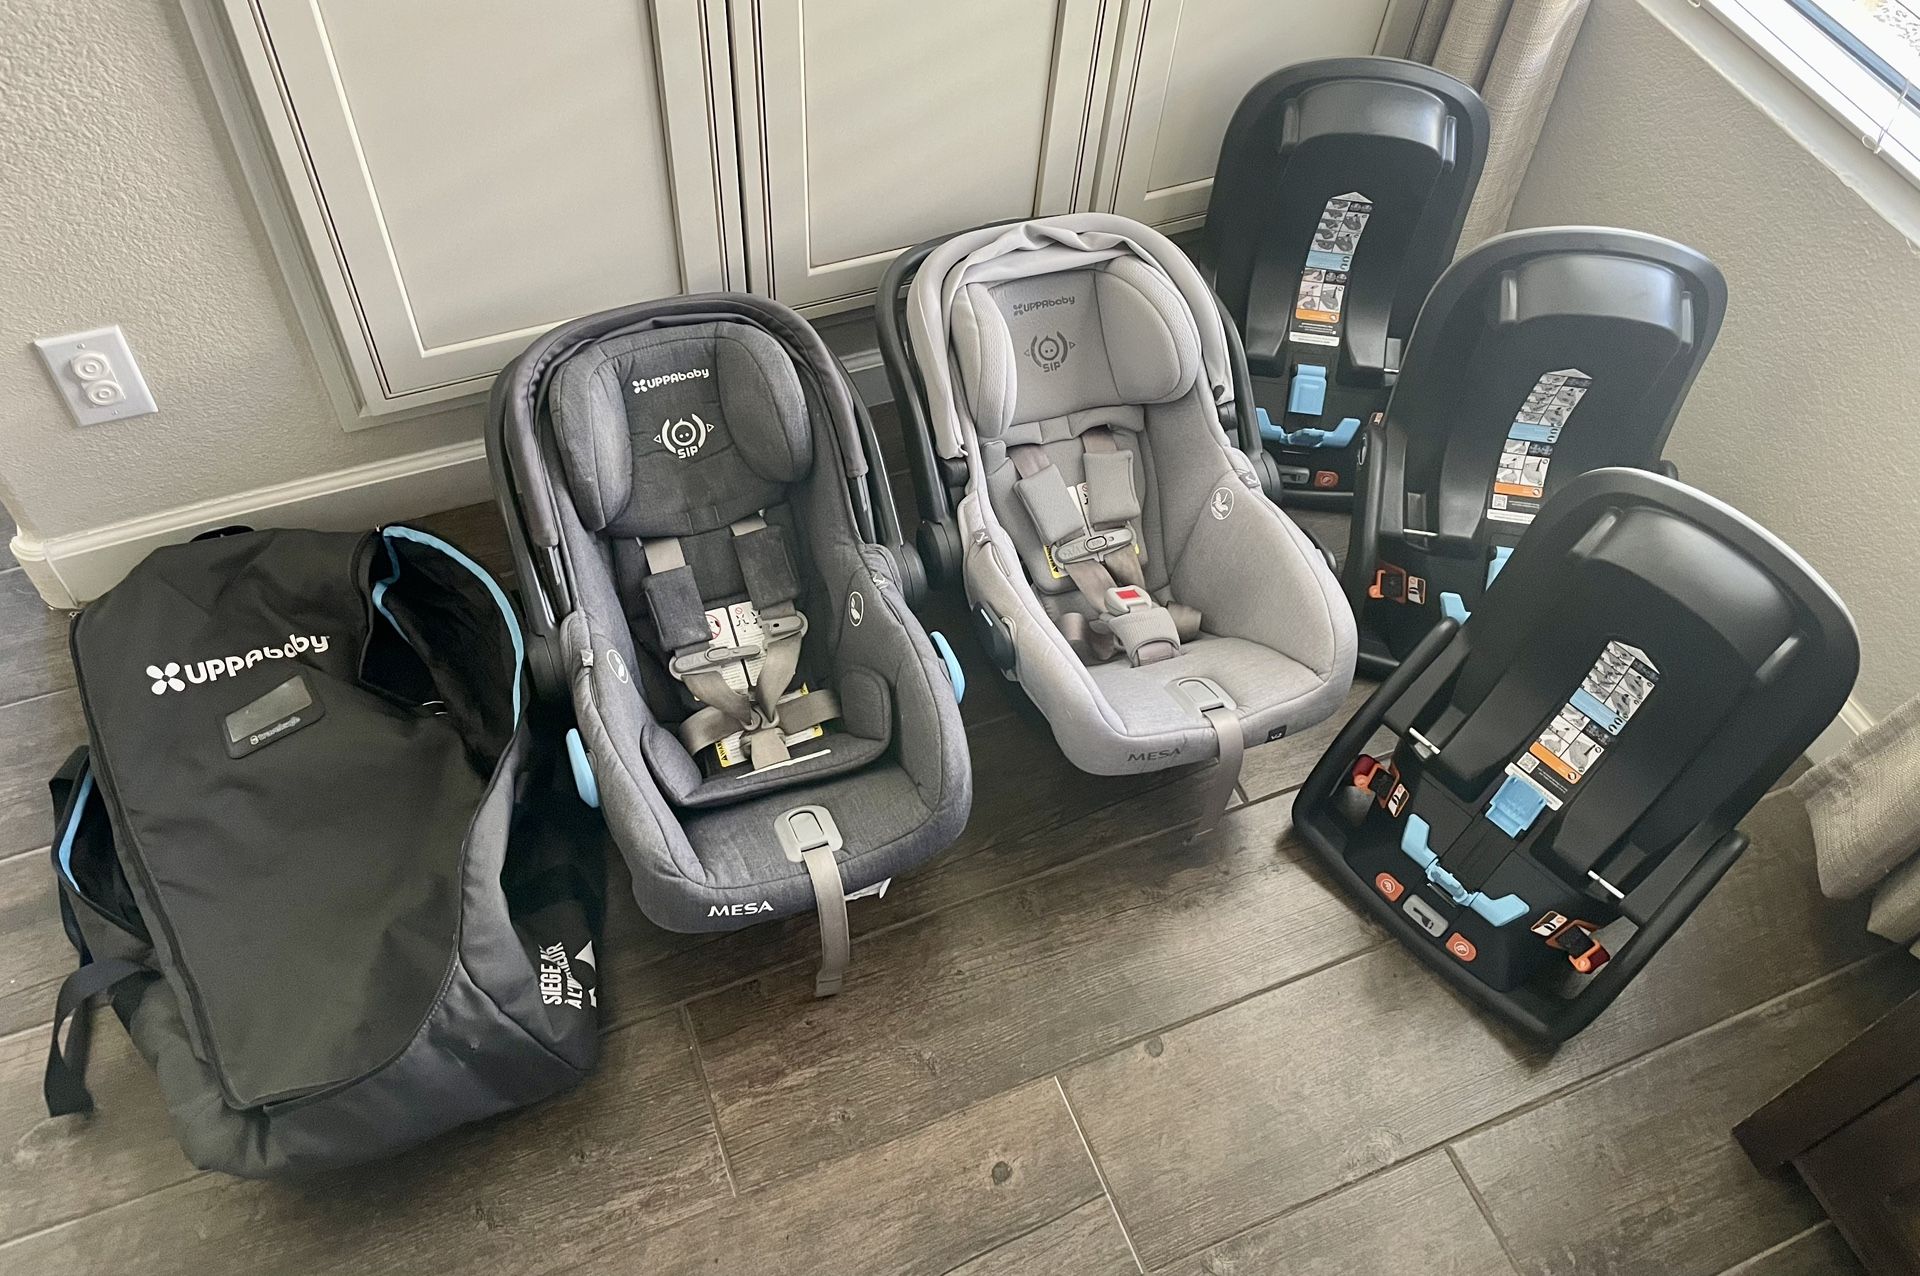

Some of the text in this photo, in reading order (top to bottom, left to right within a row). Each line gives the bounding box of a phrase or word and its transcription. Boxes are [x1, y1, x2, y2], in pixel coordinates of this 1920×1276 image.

[1023, 296, 1075, 312] UPPAbaby
[1043, 361, 1061, 373] SIP
[646, 368, 710, 389] UPPAbaby
[677, 445, 699, 459] SIP
[184, 633, 330, 684] UPPAbaby
[1127, 747, 1181, 762] MESA
[707, 900, 774, 917] MESA
